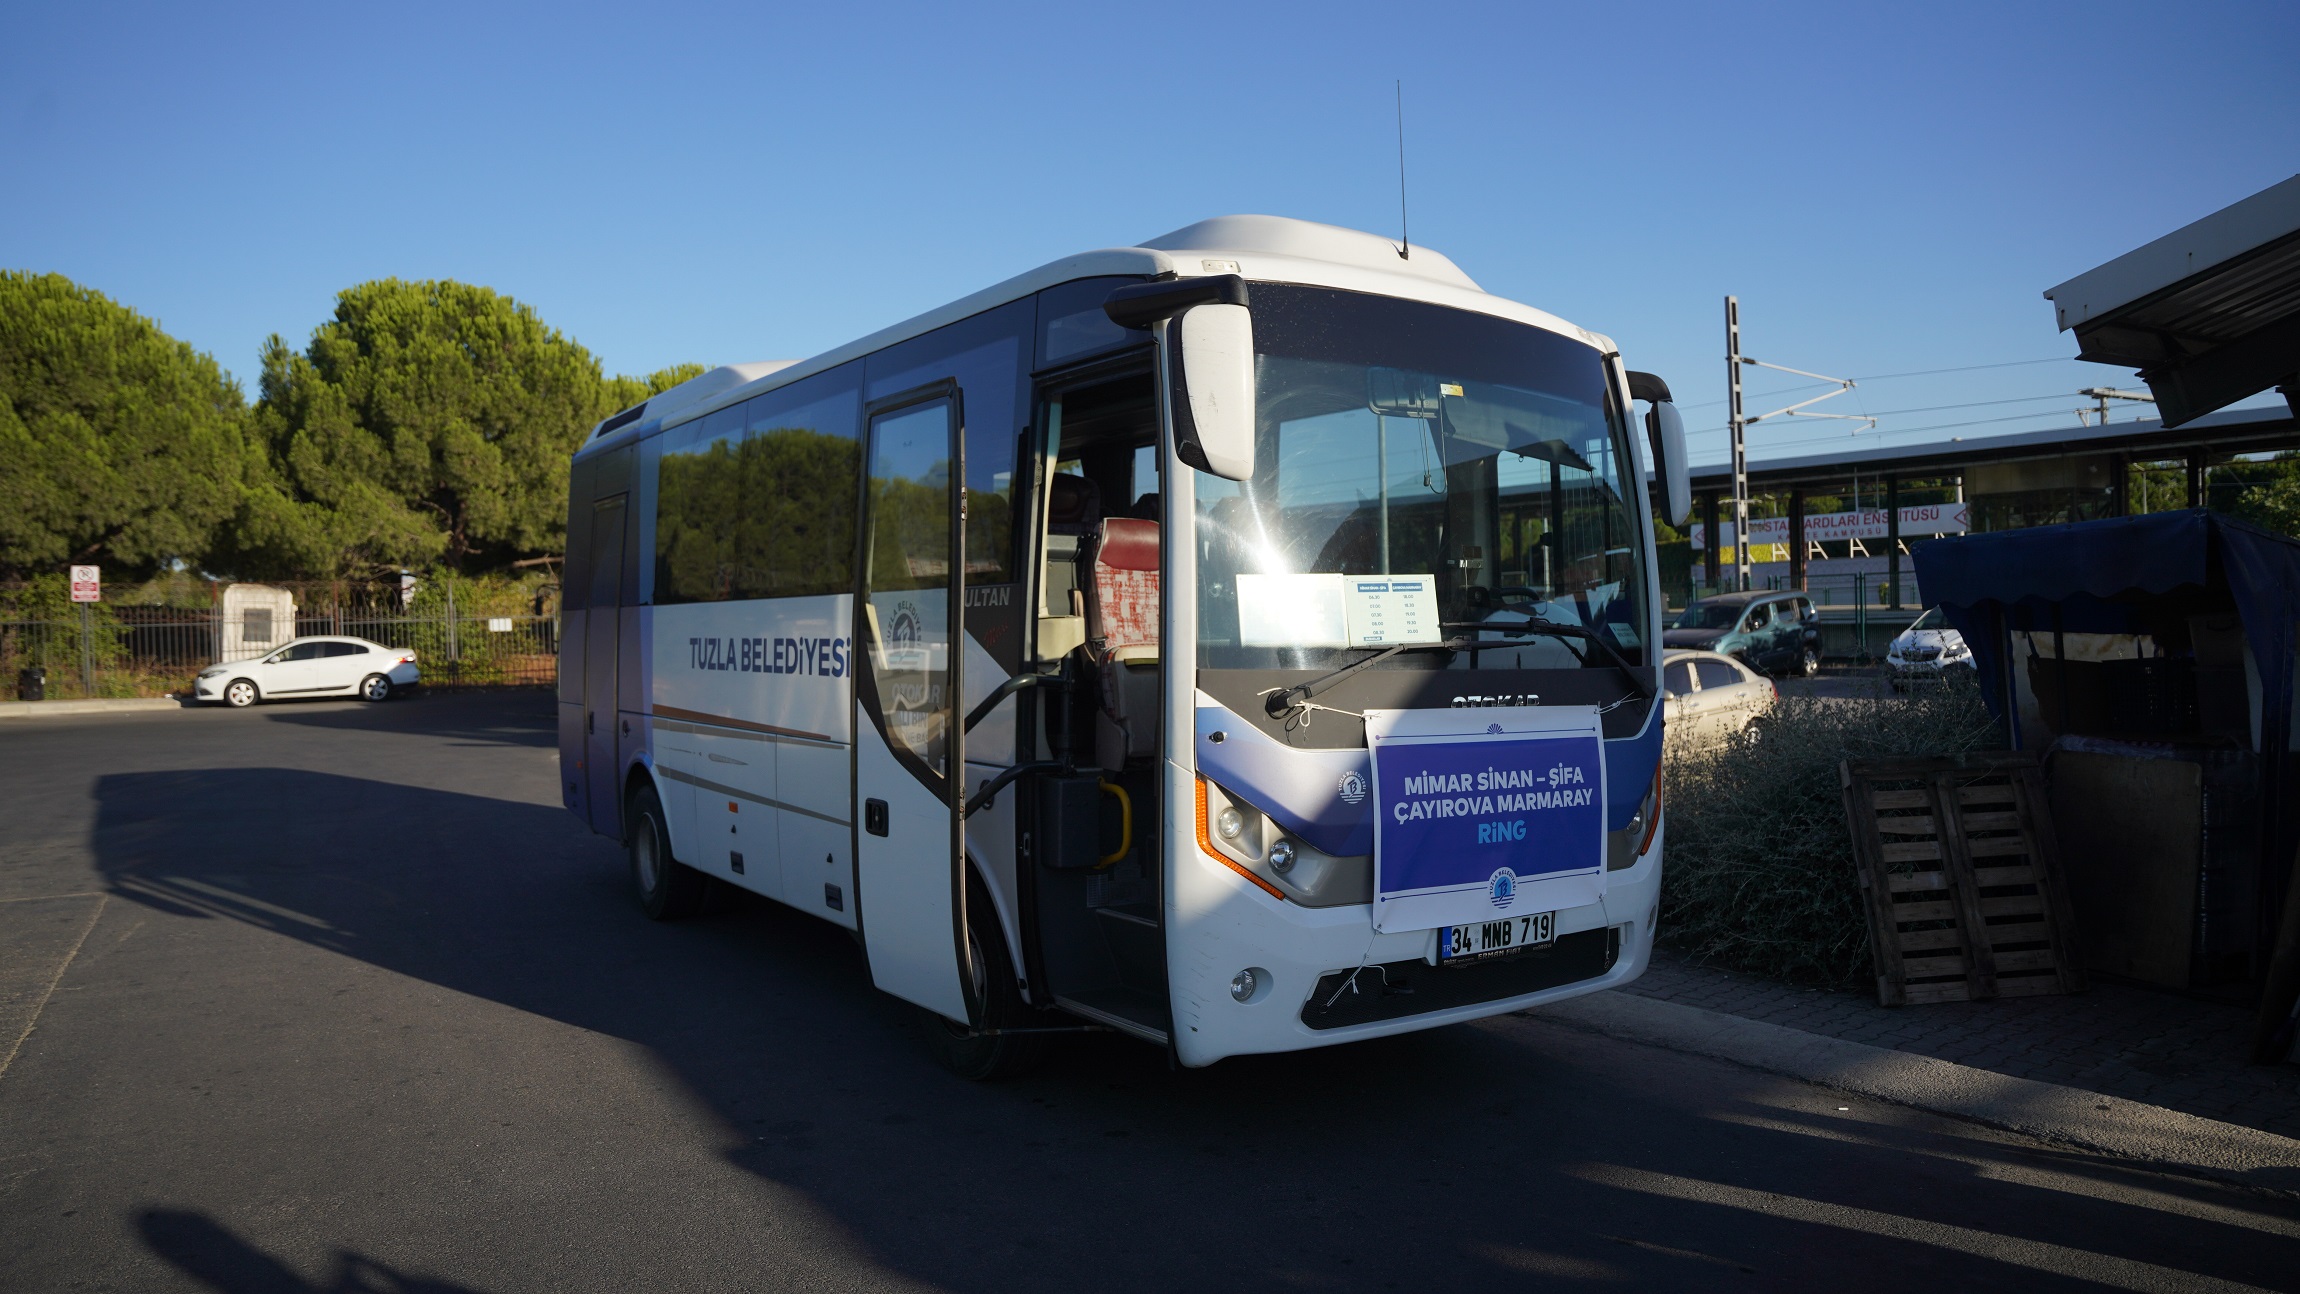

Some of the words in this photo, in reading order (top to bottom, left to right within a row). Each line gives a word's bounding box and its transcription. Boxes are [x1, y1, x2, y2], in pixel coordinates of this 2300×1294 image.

[1765, 514, 1859, 532] STAARDLARI
[1863, 505, 1939, 525] ENSİTÜSÜ
[964, 587, 1010, 607] ULTAN
[689, 637, 737, 671] TUZLA
[1404, 770, 1473, 796] MİMAR
[1477, 766, 1533, 791] SİNAN
[1549, 762, 1584, 789] ŞİFA
[1393, 796, 1494, 825] ÇAYIROVA
[1497, 788, 1593, 815] MARMARAY
[1443, 944, 1451, 952] TR
[1451, 926, 1472, 954] 34
[1481, 920, 1512, 949] MNB
[1520, 915, 1549, 943] 719
